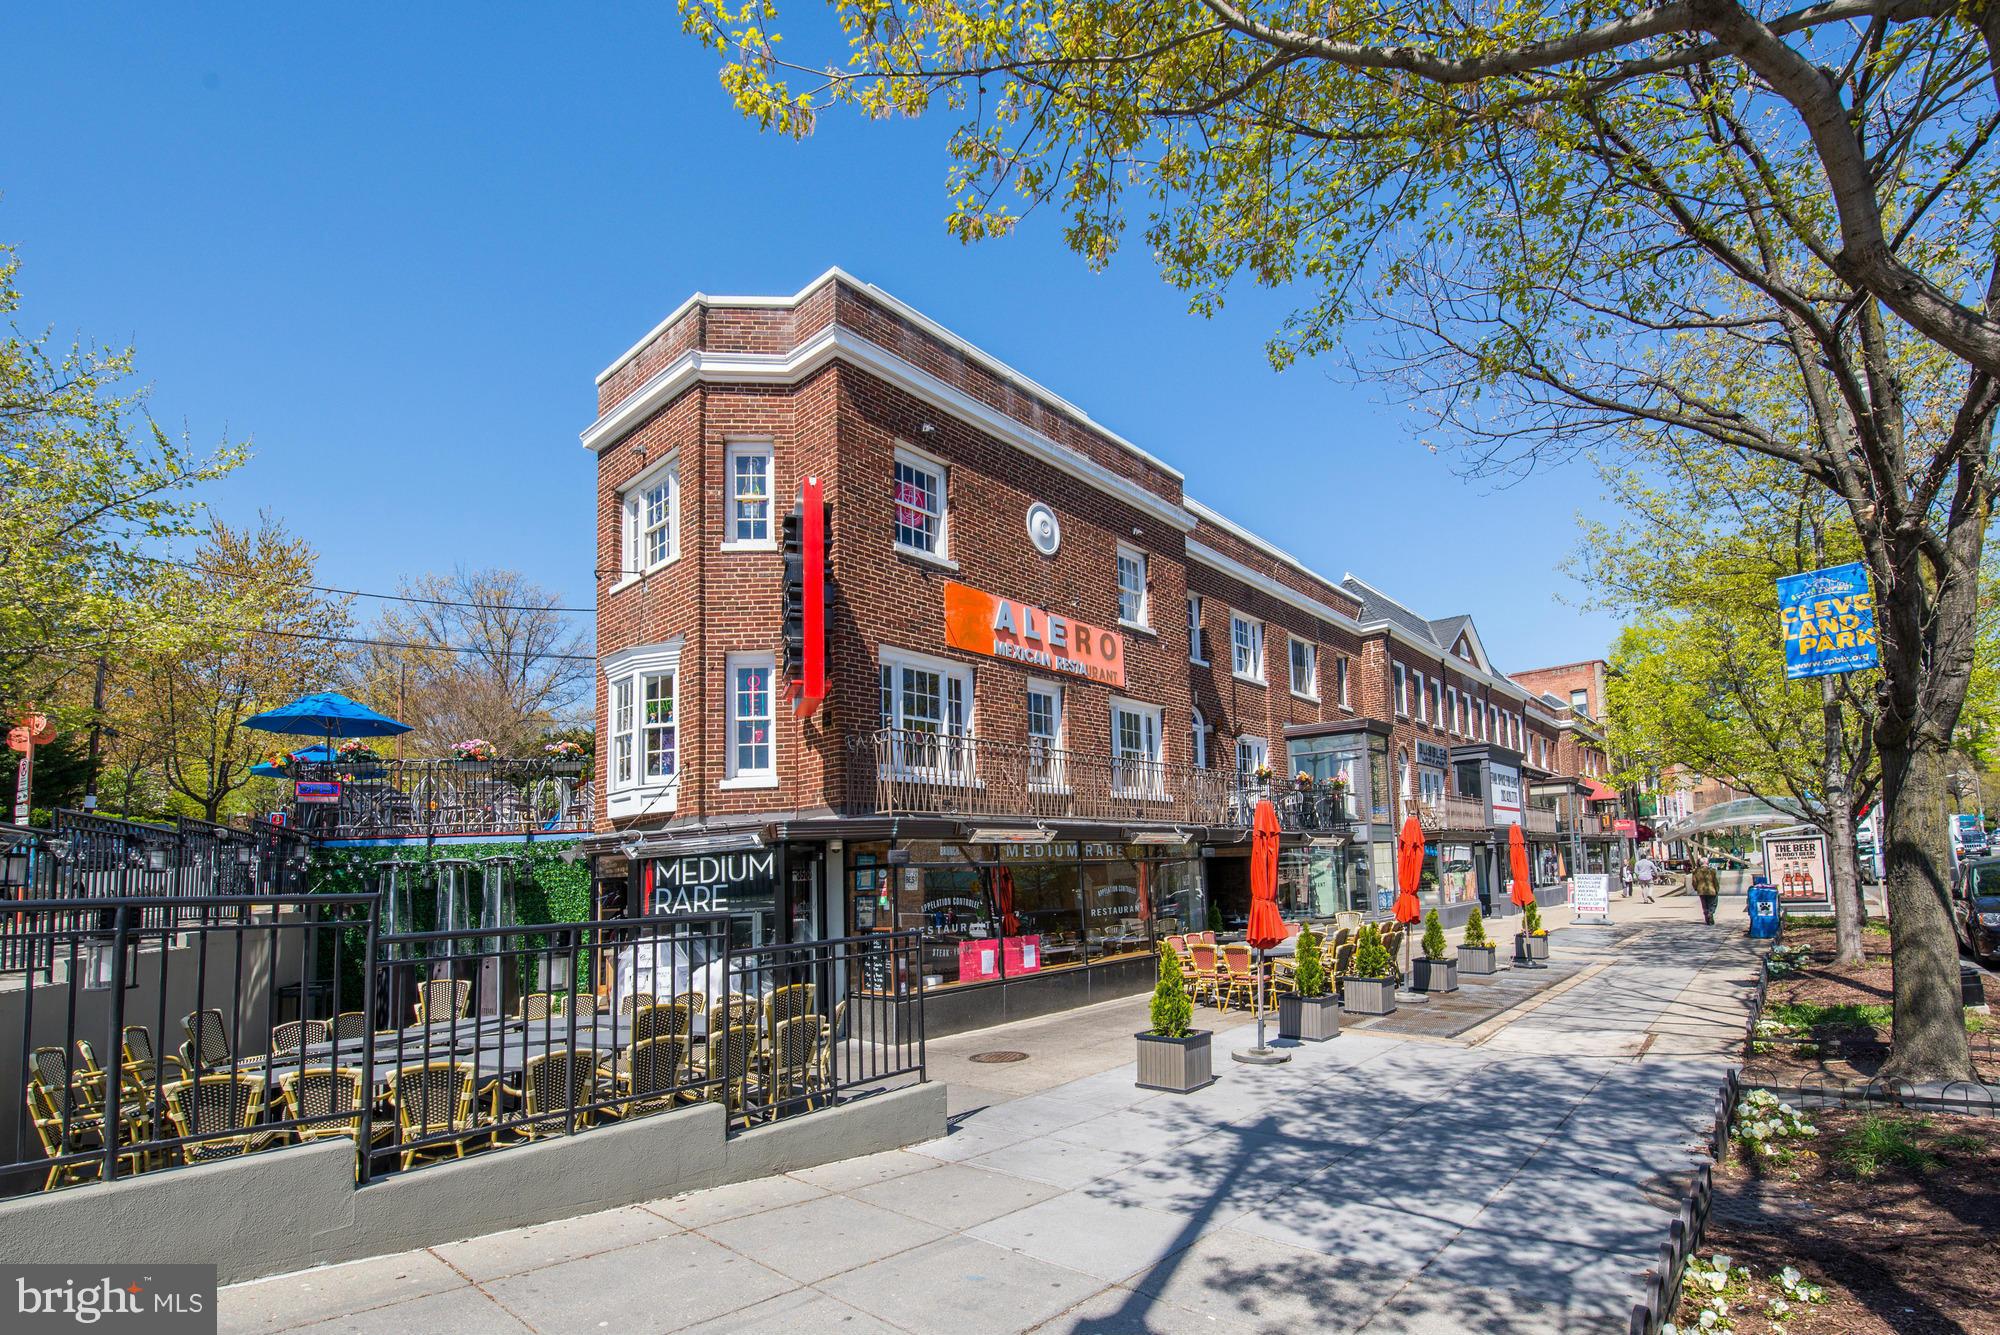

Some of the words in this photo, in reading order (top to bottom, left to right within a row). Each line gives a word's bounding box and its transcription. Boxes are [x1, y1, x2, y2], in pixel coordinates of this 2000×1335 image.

[1780, 593, 1872, 623] CLEVE
[994, 600, 1116, 660] ALERO
[1783, 614, 1860, 640] LAND
[1799, 628, 1876, 655] PARK
[994, 640, 1050, 667] MEXICAN
[1056, 656, 1118, 683] RESTAURANT
[1006, 844, 1079, 858] MEDIUM
[1085, 844, 1124, 857] RARE
[656, 852, 774, 887] MEDIUM
[655, 884, 729, 915] RARE
[1091, 904, 1144, 917] RESTAURANT
